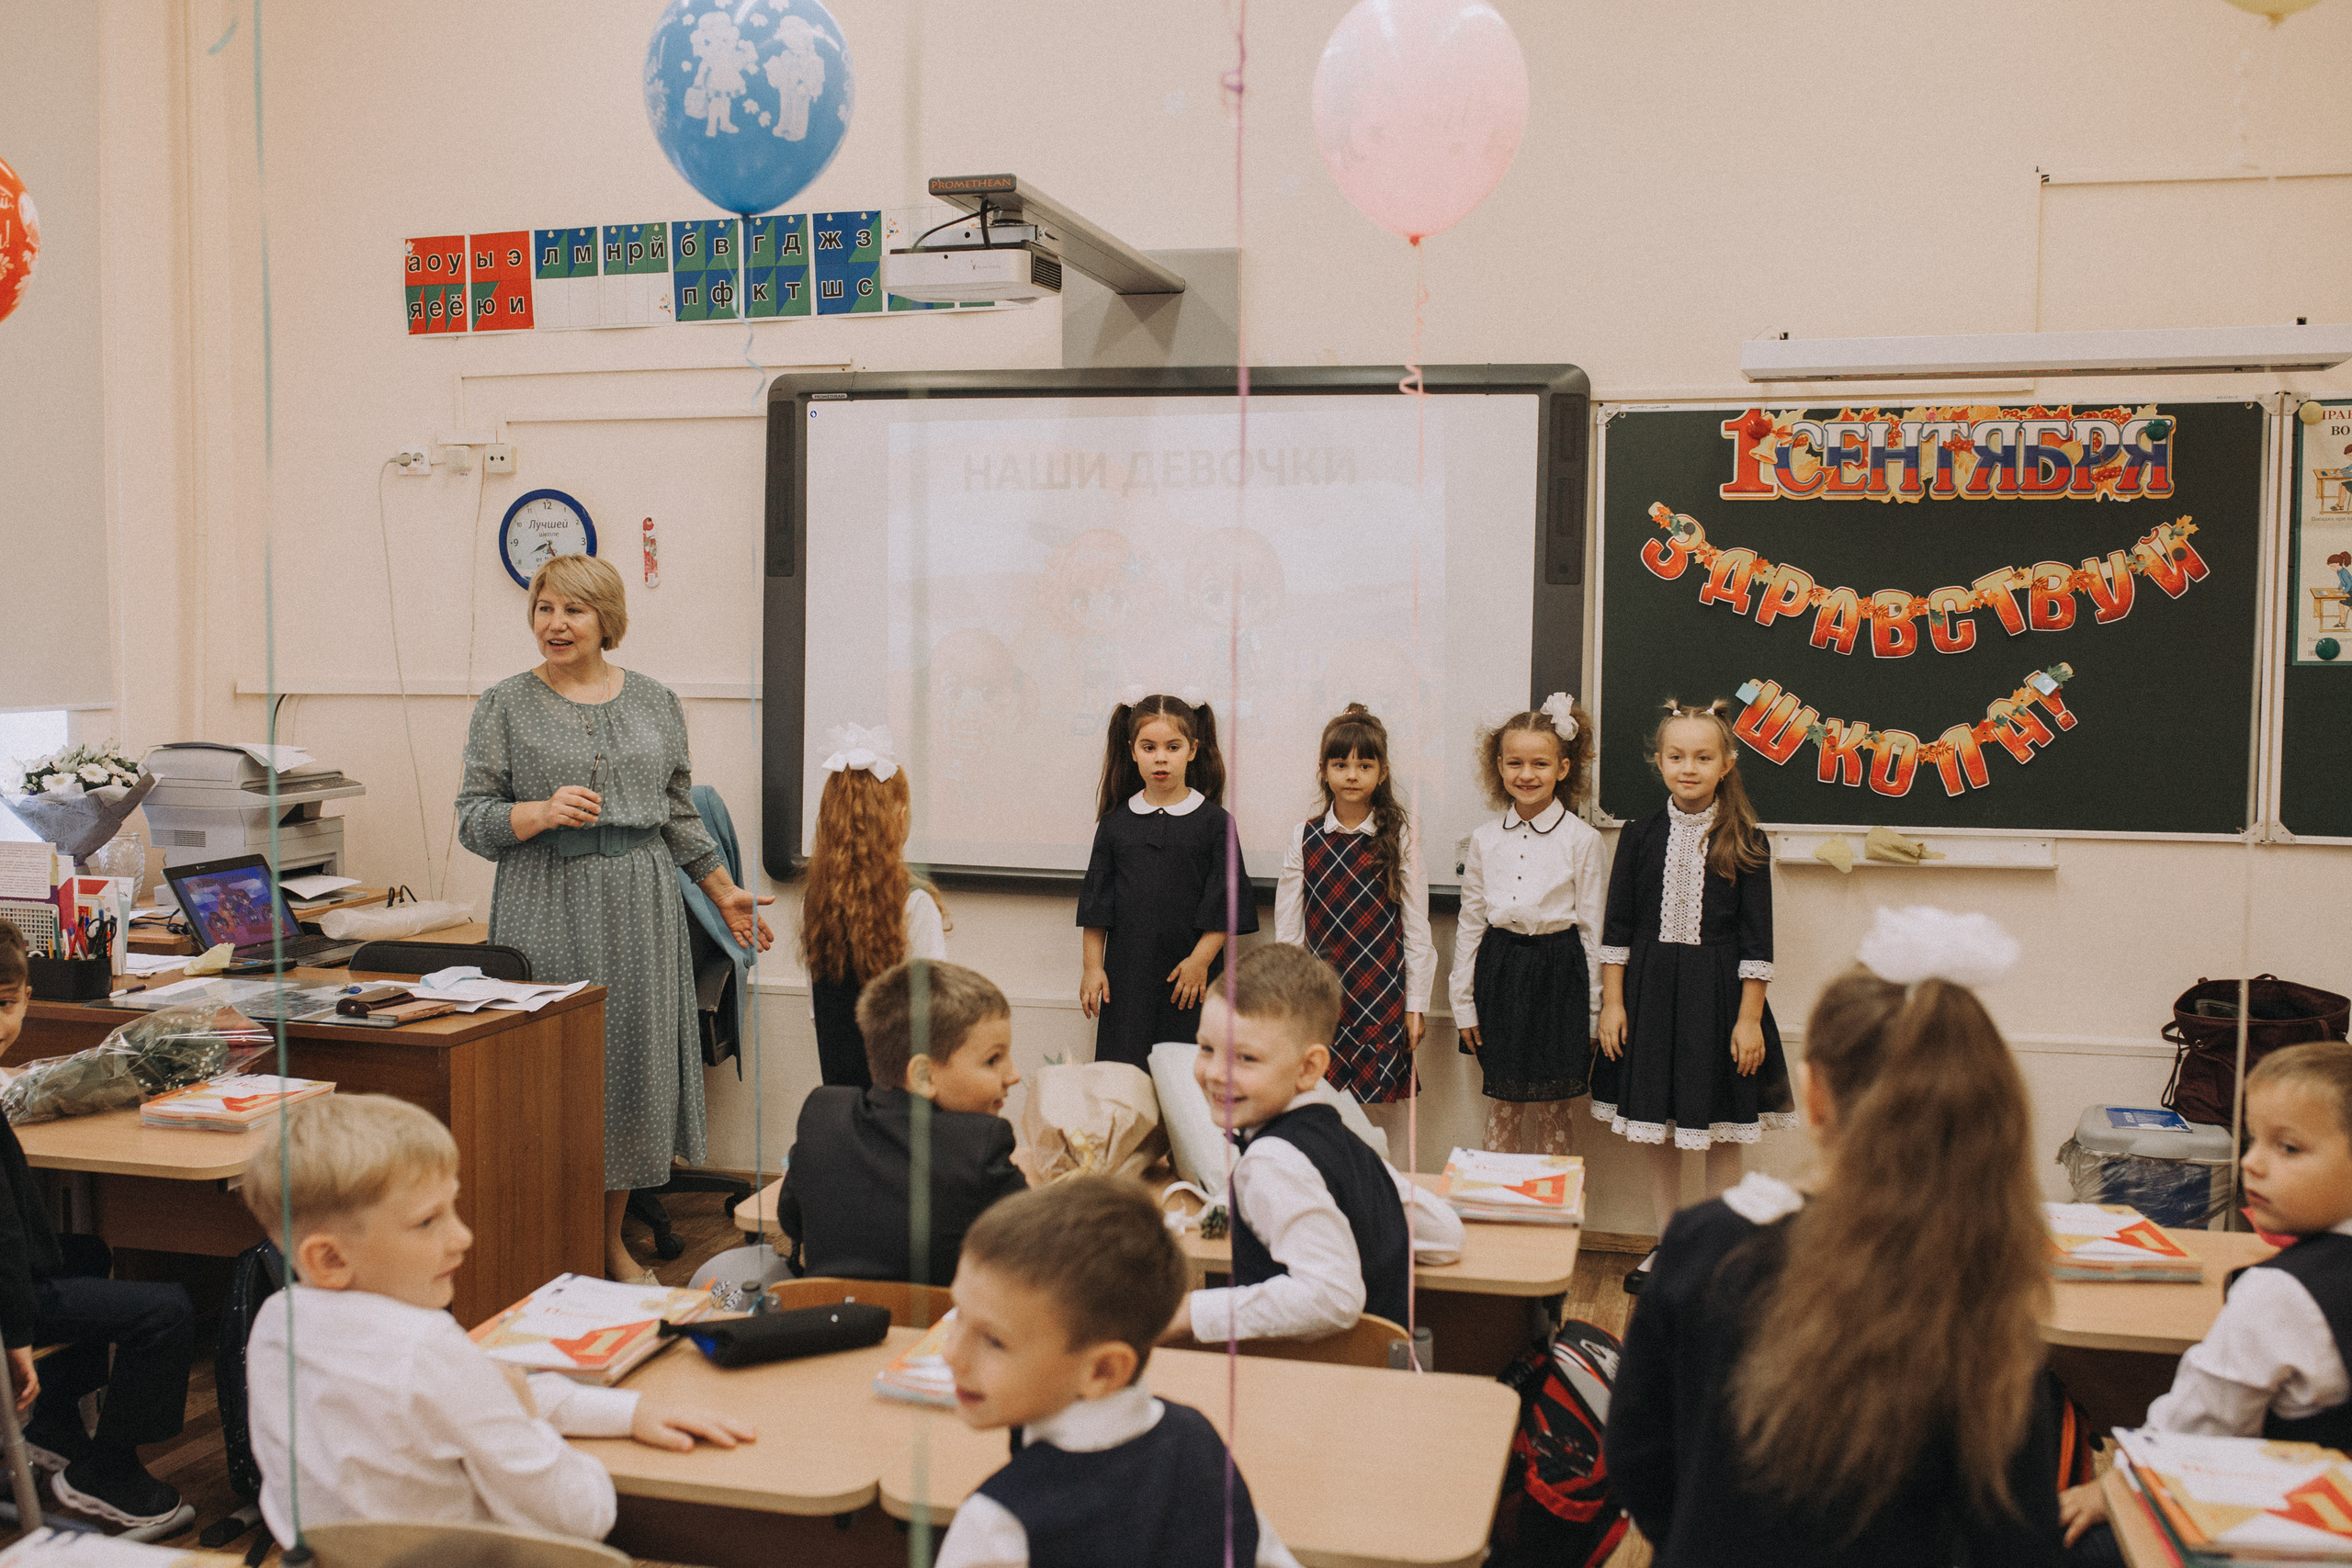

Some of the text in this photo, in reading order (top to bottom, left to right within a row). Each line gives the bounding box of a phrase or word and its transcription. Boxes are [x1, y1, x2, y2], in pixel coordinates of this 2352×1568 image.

[931, 178, 1012, 190] PROMETHEAN
[2331, 425, 2350, 436] ВО
[1719, 406, 2175, 496] 1 СЕНТЯБРЯ
[963, 446, 1357, 497] НАШИ ДЕВОЧКИ
[543, 502, 552, 510] 12
[528, 519, 569, 533] Лучшей
[514, 538, 519, 547] 9
[581, 537, 586, 546] 3
[1639, 513, 2211, 659] ЗДРАВСТВУЙ
[1733, 671, 2078, 796] ШКОЛА!
[572, 1328, 628, 1357] 1
